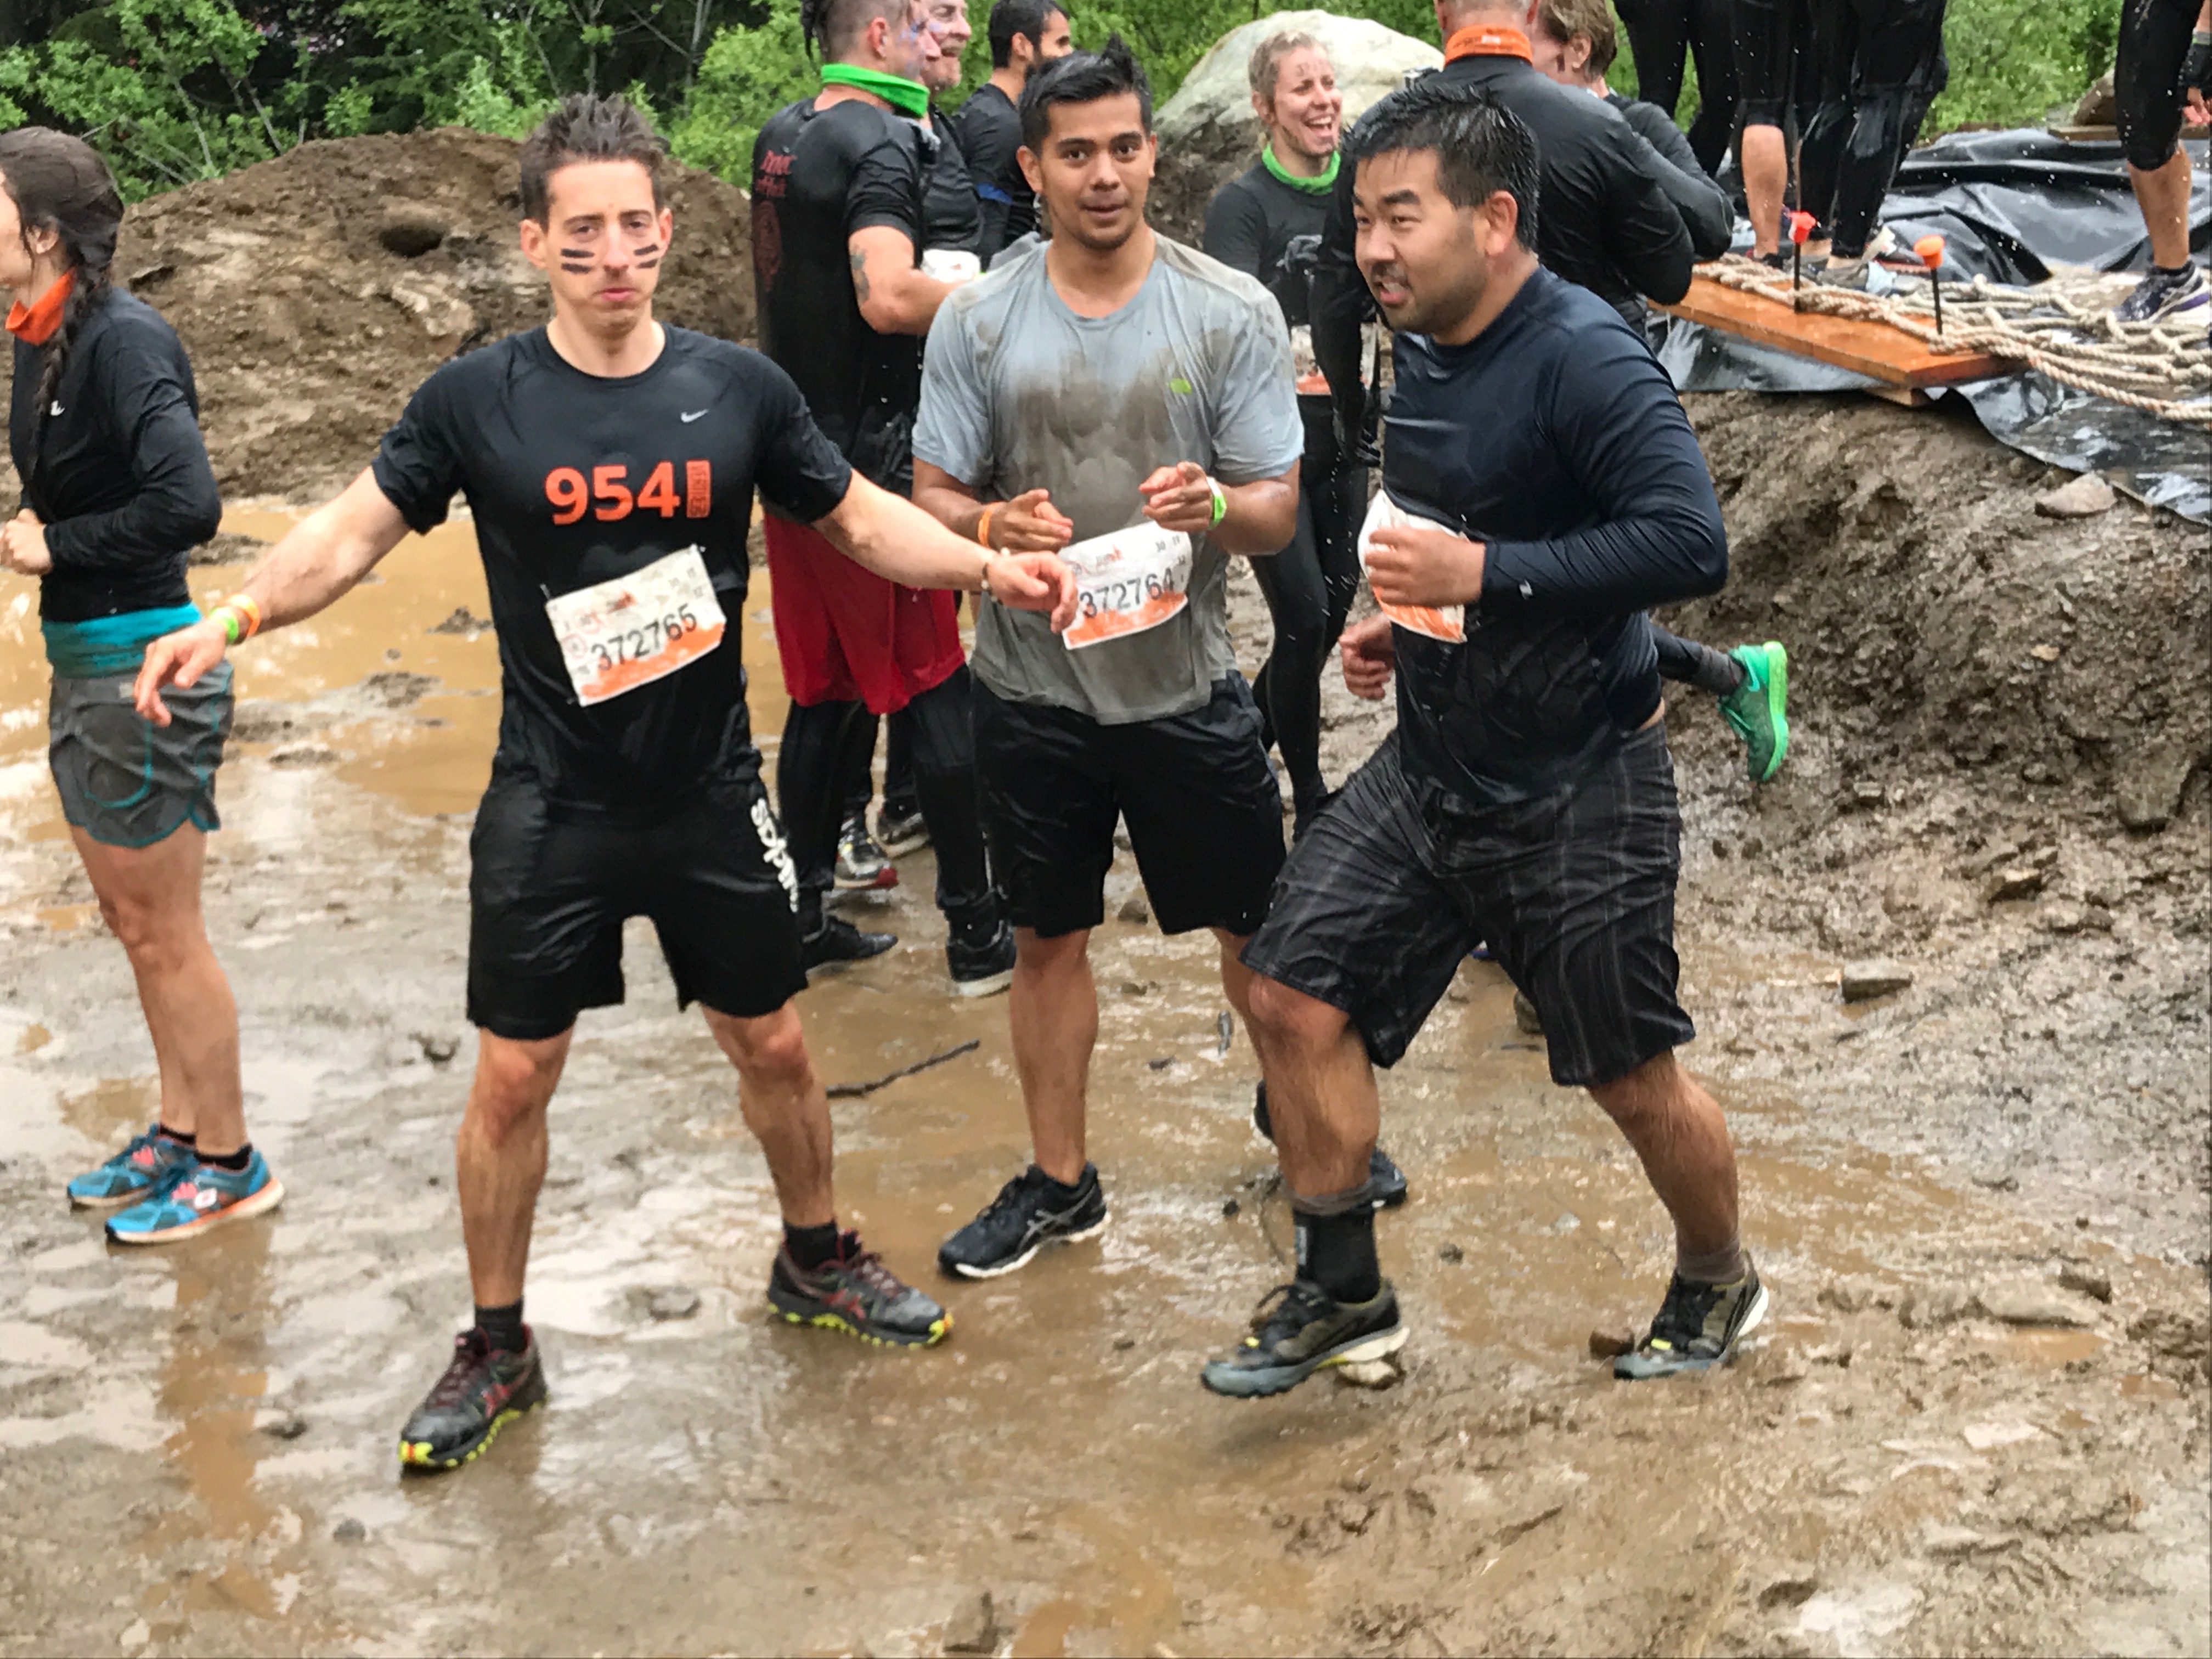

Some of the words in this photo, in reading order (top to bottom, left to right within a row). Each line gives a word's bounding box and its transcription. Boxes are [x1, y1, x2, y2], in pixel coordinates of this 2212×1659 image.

[544, 459, 681, 526] 954
[1079, 567, 1175, 618] 372764
[590, 603, 697, 671] 372765
